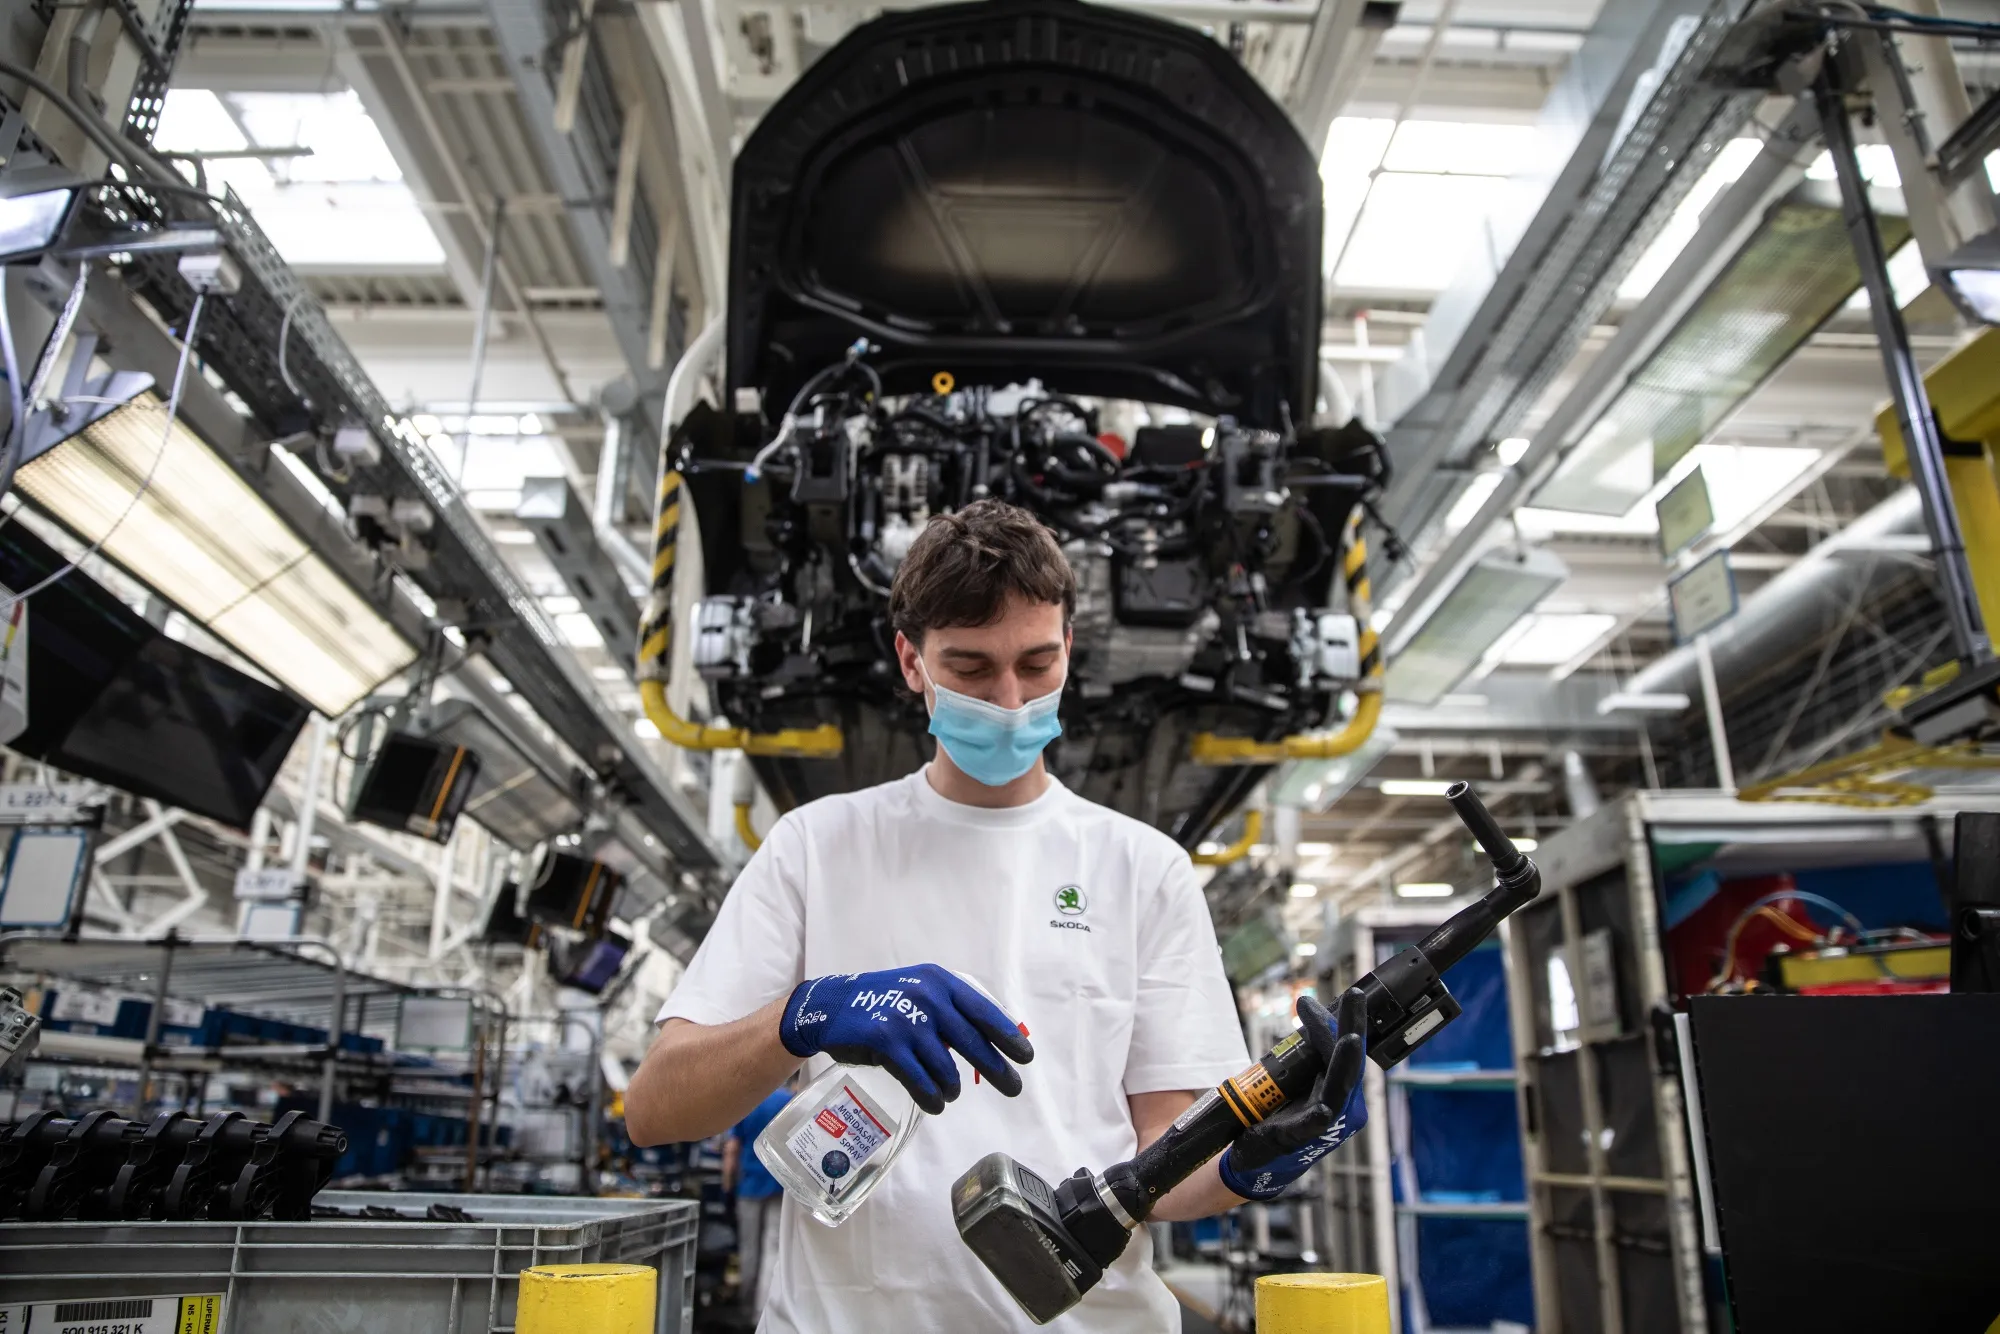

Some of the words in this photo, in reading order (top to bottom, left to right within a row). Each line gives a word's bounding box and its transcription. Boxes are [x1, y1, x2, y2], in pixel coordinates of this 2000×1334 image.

[1050, 920, 1091, 933] ŠKODA
[838, 1104, 877, 1147] MERIDASAN
[840, 1138, 863, 1161] SPRAY
[852, 1135, 871, 1154] Profi
[134, 1323, 144, 1334] K
